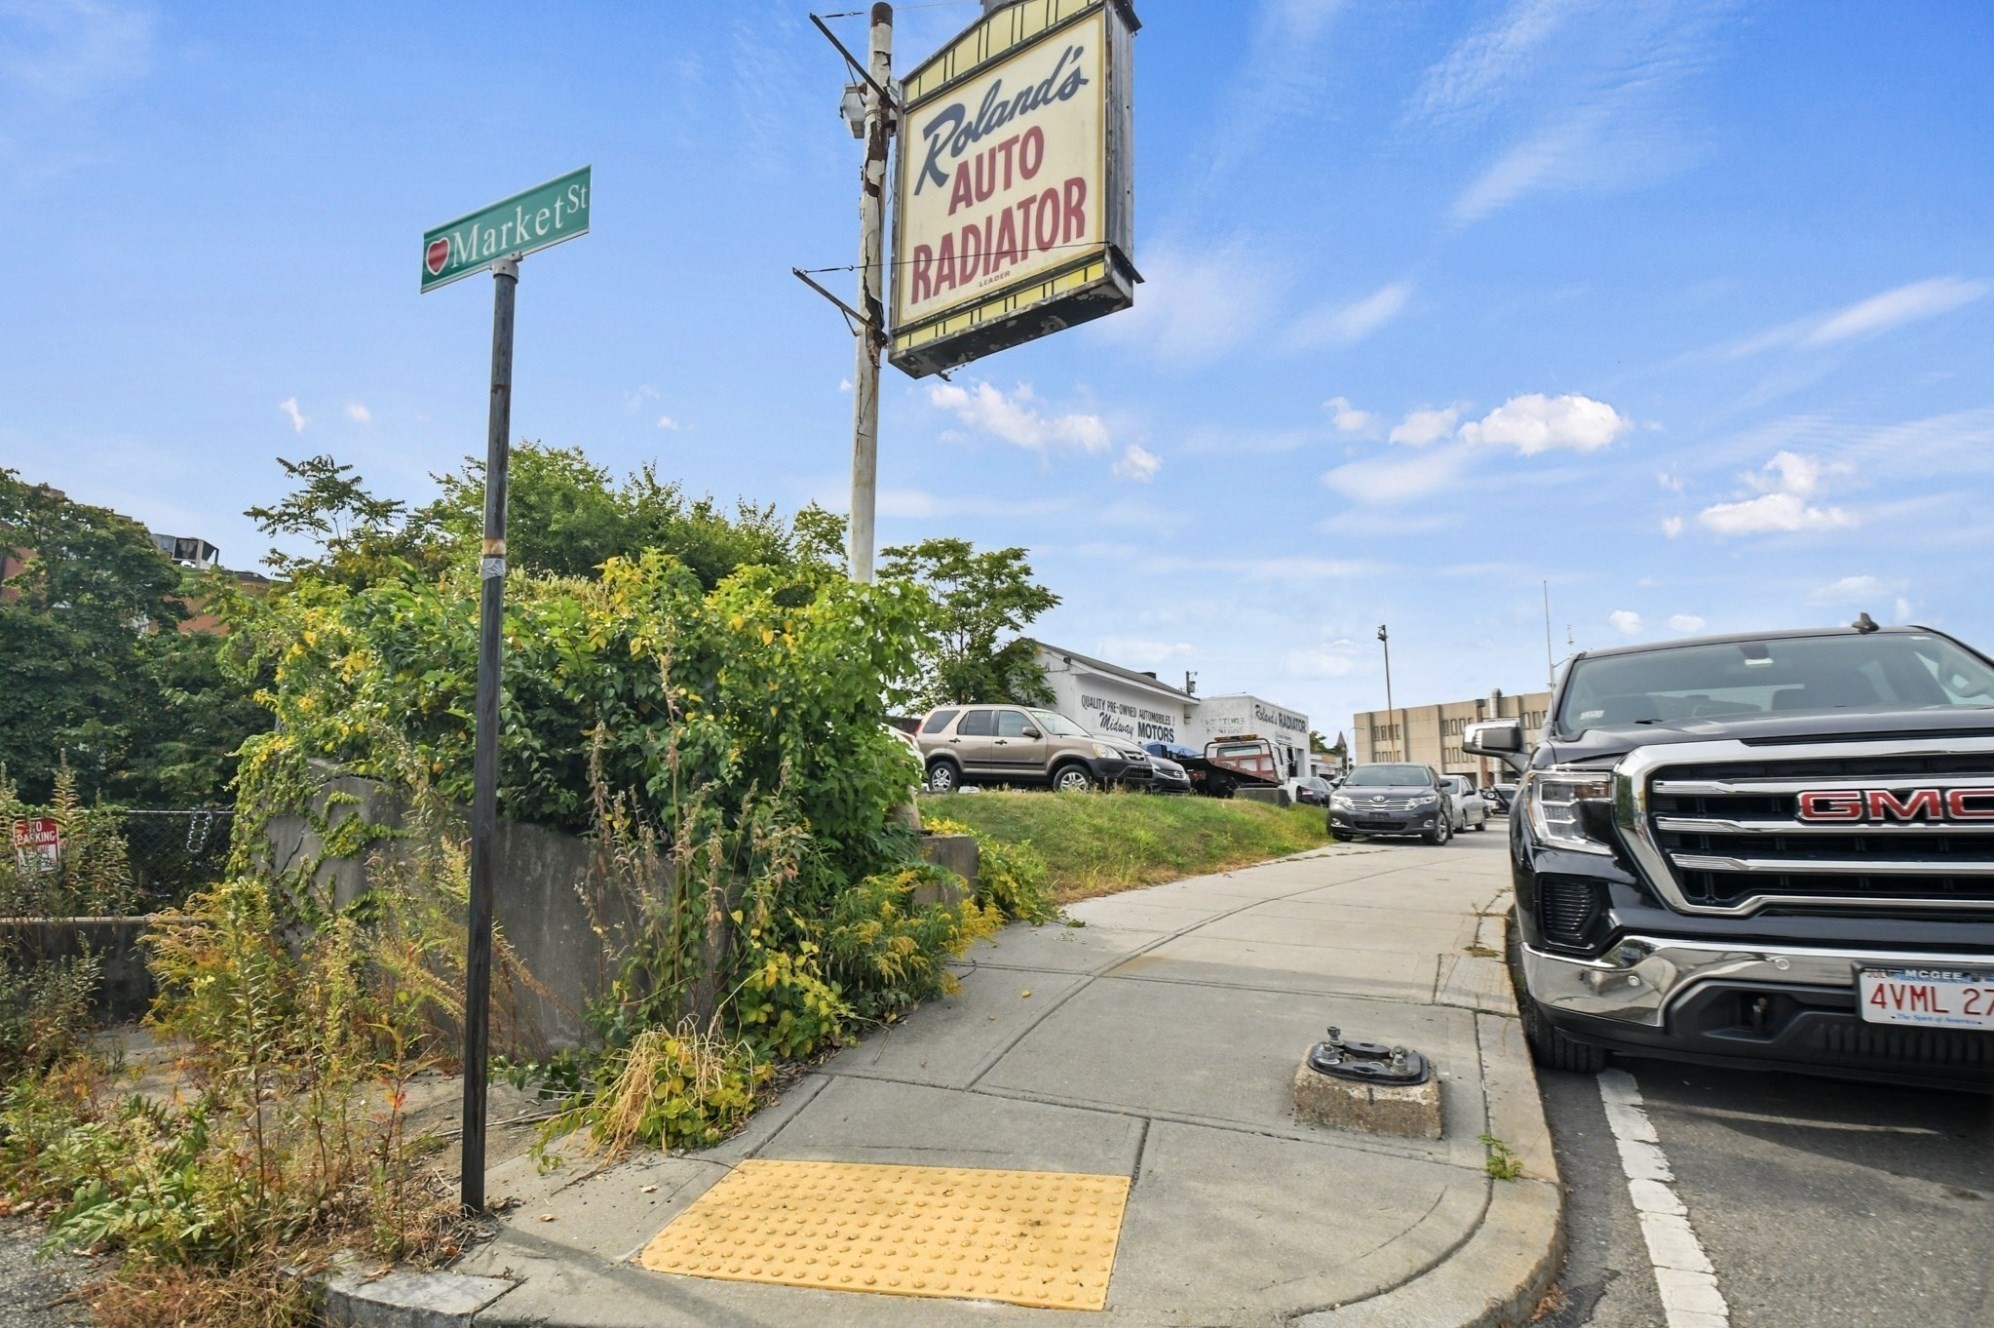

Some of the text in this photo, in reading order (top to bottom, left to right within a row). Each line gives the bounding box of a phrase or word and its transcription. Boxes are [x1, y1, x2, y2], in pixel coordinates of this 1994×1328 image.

[914, 45, 1089, 195] Roland's
[948, 126, 1044, 216] AUTO
[451, 184, 587, 269] Market St
[911, 177, 1087, 305] RADIATOR
[979, 270, 1011, 288] LEADER
[1081, 694, 1106, 711] QUALITY
[1107, 700, 1137, 718] PRE-OWNED
[1099, 712, 1175, 743] Midway MOTORS
[1278, 712, 1307, 734] RADIATOR
[1797, 788, 1994, 821] GMC
[1904, 969, 1963, 980] MCGEE
[1870, 983, 1950, 1014] 4VML
